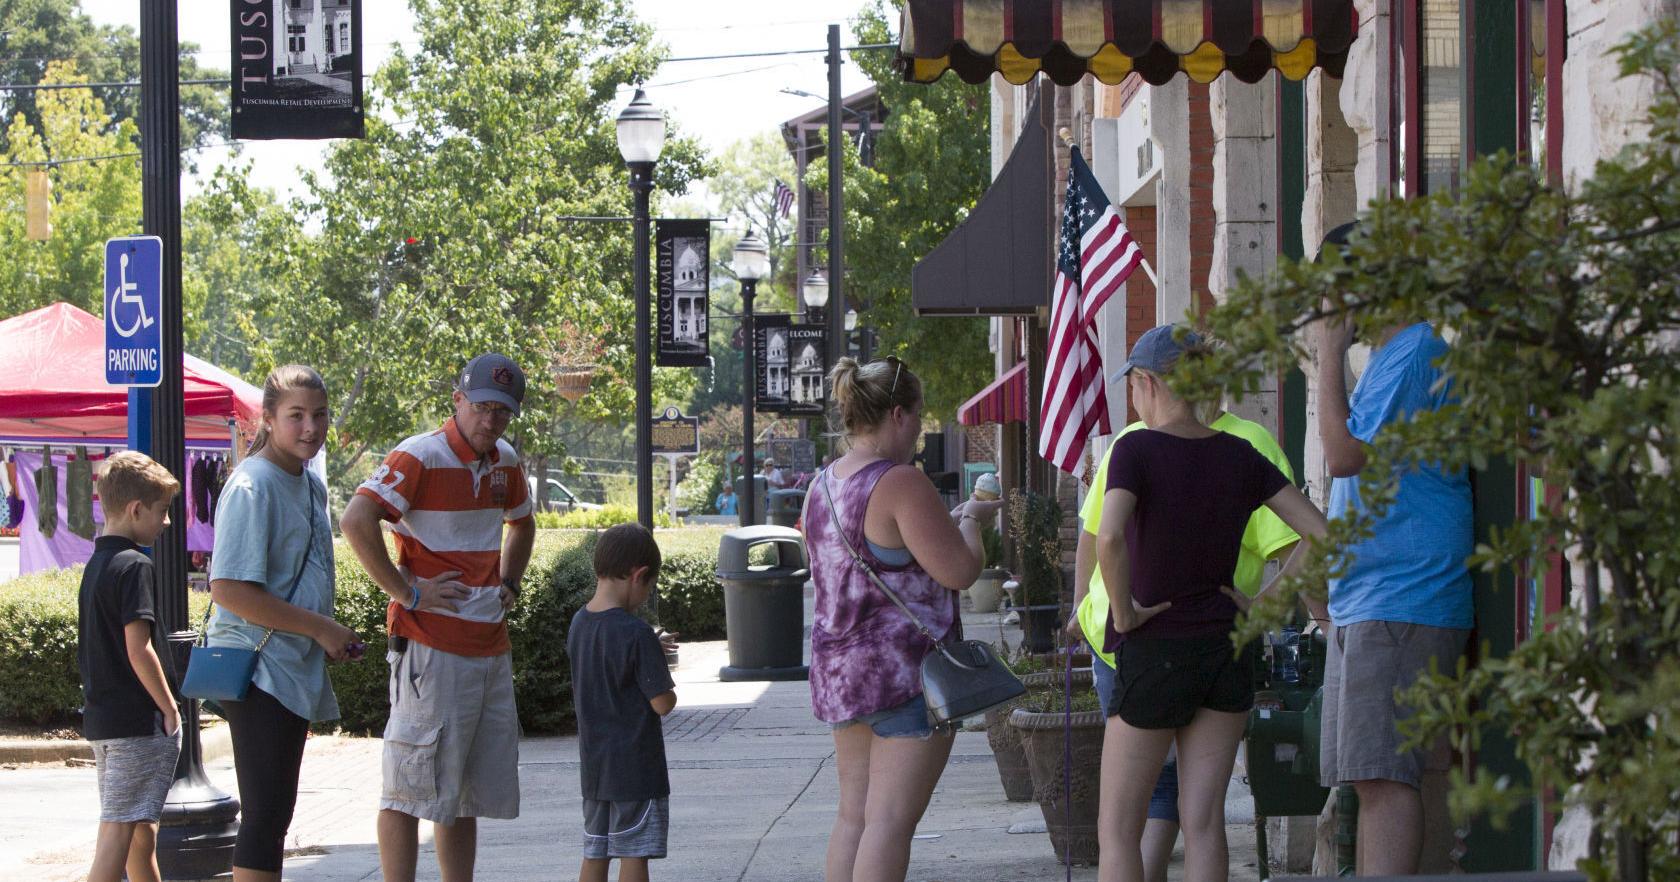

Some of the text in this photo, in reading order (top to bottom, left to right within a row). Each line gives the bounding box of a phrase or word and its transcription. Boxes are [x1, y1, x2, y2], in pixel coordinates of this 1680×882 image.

[240, 0, 267, 92] TUS
[660, 238, 672, 344] TUSCUMBIA
[109, 348, 157, 371] PARKING
